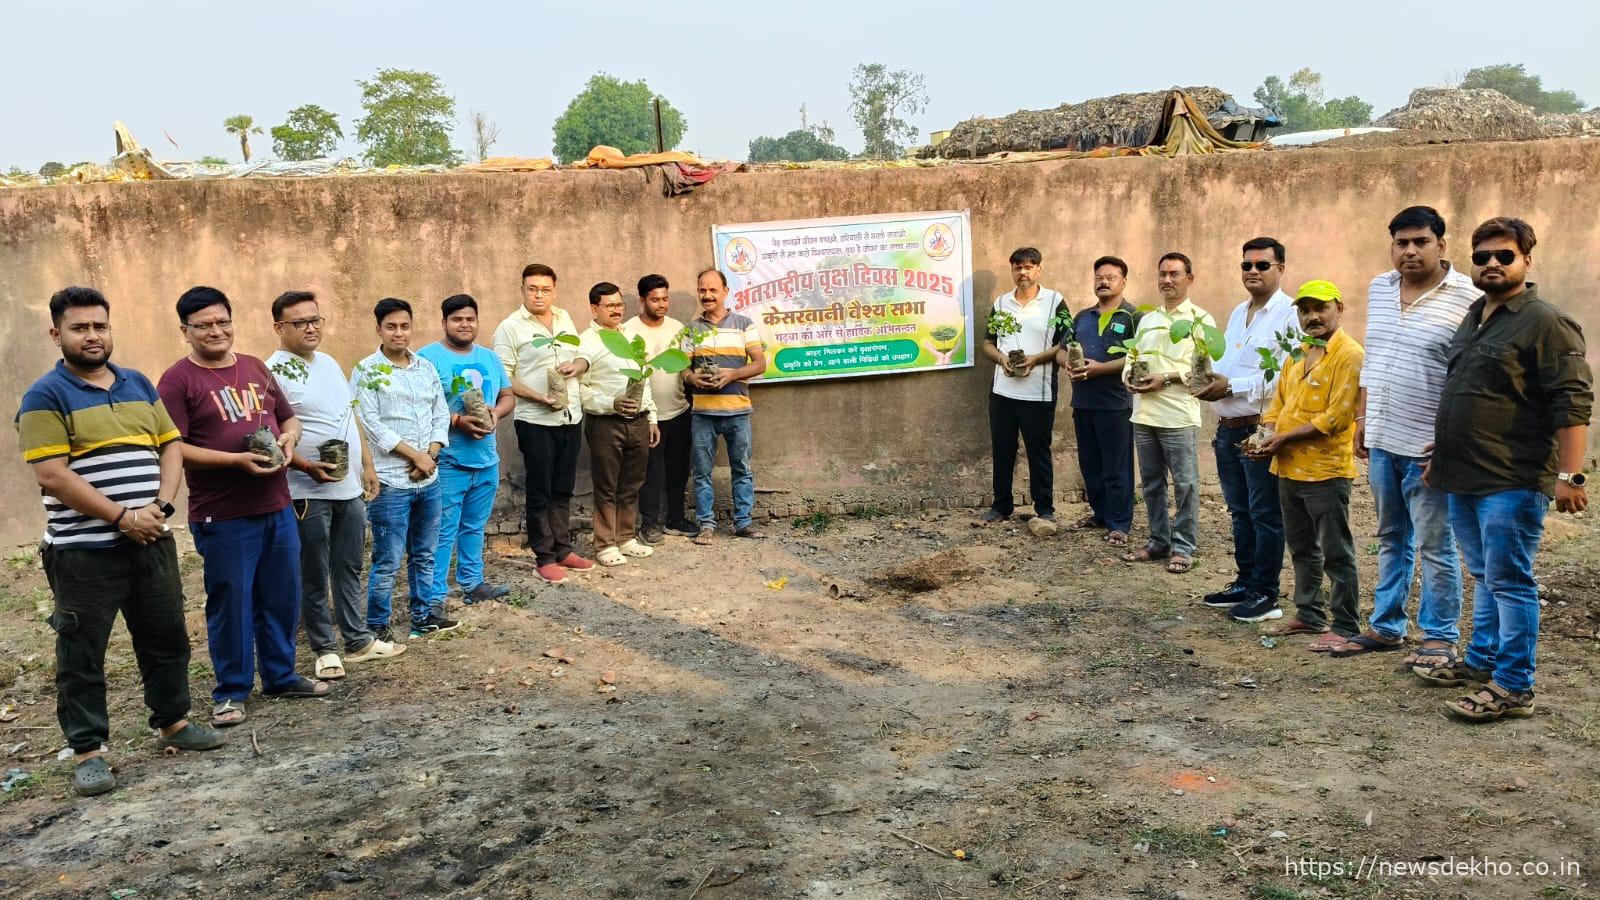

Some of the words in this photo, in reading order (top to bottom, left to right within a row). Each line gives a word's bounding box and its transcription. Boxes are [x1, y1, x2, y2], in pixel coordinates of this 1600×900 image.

[864, 231, 870, 240] से
[779, 249, 786, 259] से
[733, 269, 814, 311] अंतराष्ट्रीय
[817, 267, 849, 295] वृक्ष
[853, 261, 899, 287] दिवस
[903, 268, 954, 297] 2025
[762, 301, 844, 326] केसरवानी
[848, 300, 886, 320] वैश्य
[889, 300, 926, 317] सभा
[801, 327, 813, 341] की
[816, 327, 832, 339] ओर
[835, 326, 843, 338] से
[846, 324, 873, 338] हार्दिक
[876, 322, 917, 335] अभिनन्दन
